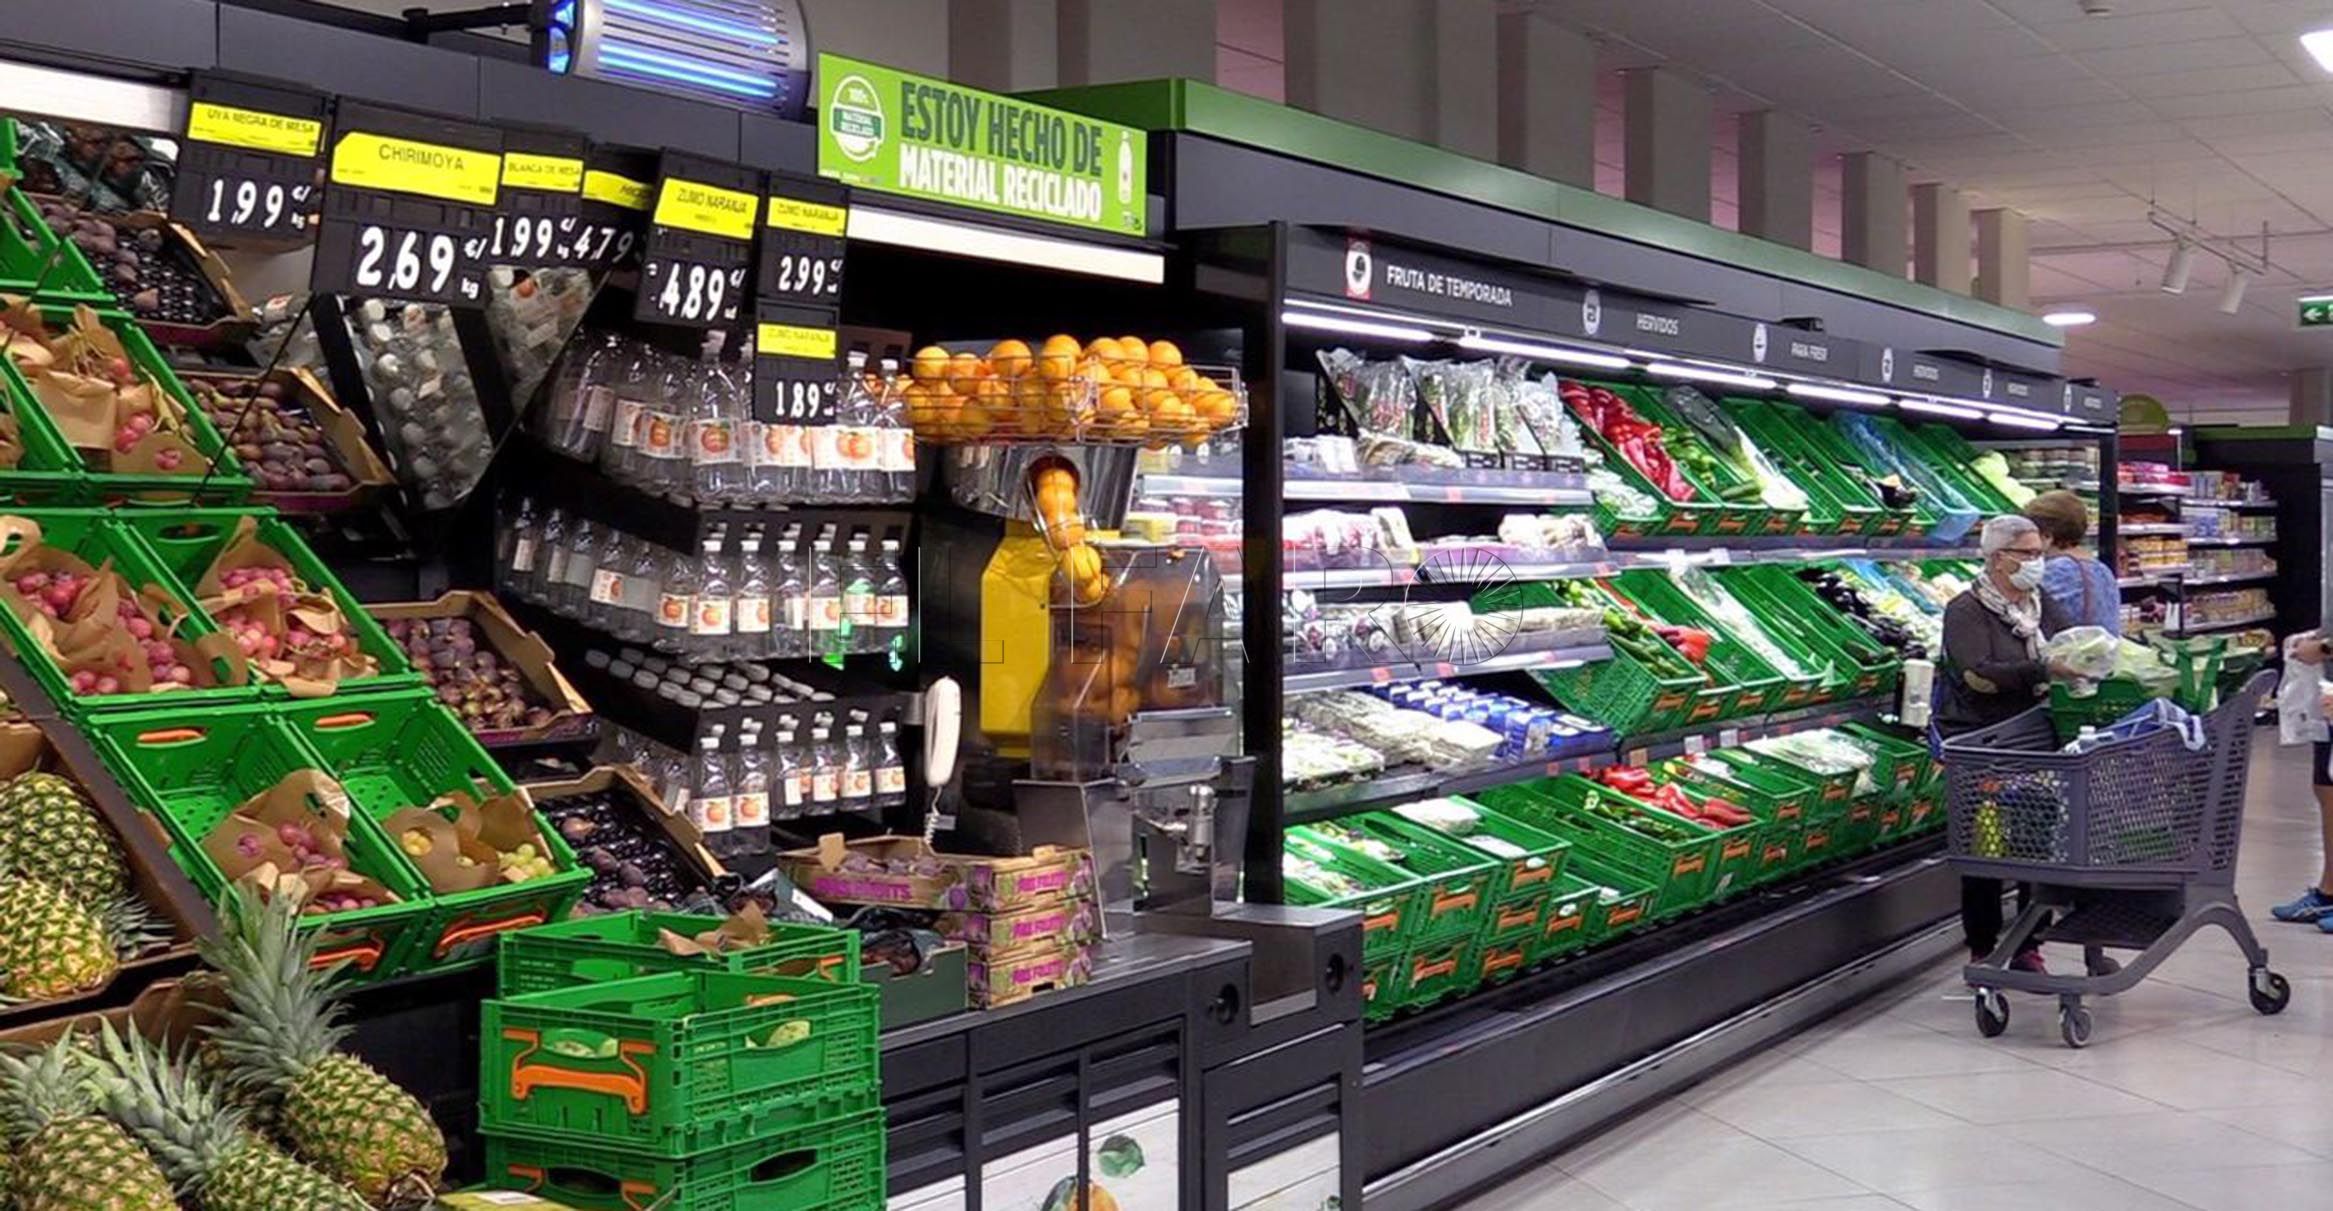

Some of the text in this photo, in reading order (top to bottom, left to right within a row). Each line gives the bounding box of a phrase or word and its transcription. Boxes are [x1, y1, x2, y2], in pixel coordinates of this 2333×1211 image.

[378, 143, 465, 171] CHIRIMOYA
[901, 81, 1103, 178] ESTOY HECHO DE
[900, 144, 1103, 223] MATERIAL RECICLADO
[356, 225, 455, 294] 2,69
[1386, 264, 1513, 307] FRUTA DE TEMPORADA
[1636, 312, 1679, 336] HERVIDOS
